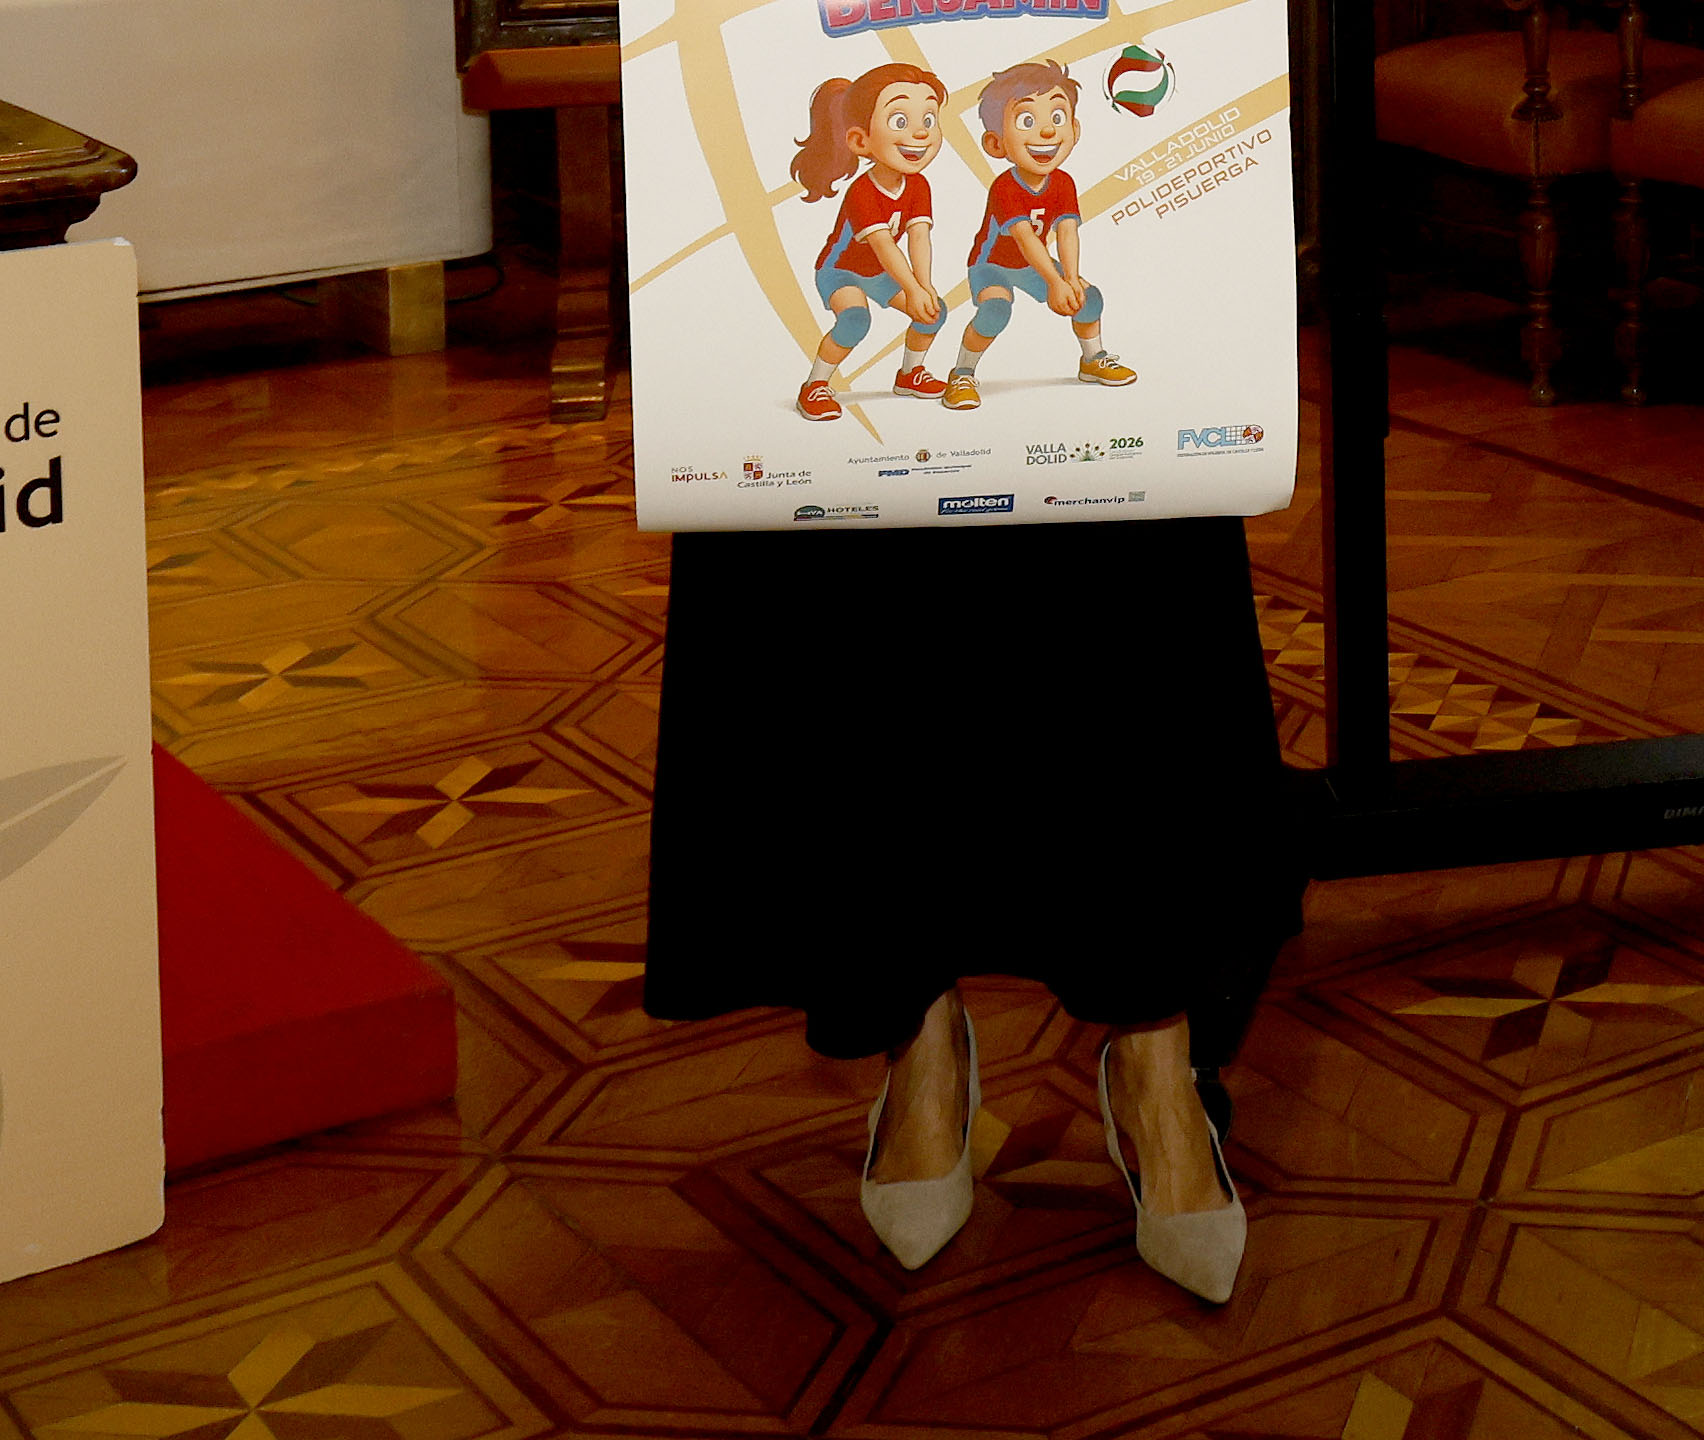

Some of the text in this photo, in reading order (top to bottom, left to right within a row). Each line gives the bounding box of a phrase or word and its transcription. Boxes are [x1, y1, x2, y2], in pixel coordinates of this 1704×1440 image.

[1114, 106, 1241, 182] VALLADOLID
[1185, 124, 1236, 158] JUNIO
[1111, 128, 1272, 225] POLIDEPORTIVO
[1155, 156, 1260, 219] PISUERGA
[1030, 208, 1046, 236] 5
[4, 401, 61, 443] de
[1026, 443, 1067, 454] VALLA
[1110, 437, 1144, 449] 2026
[848, 454, 910, 464] Ayuntamiento
[950, 448, 992, 457] Valladolid
[1026, 454, 1067, 465] DOLID
[672, 471, 728, 483] IMPULSA
[737, 477, 812, 488] Castilla y León
[943, 497, 1009, 509] molten
[1054, 496, 1125, 506] merchanvip
[827, 505, 879, 513] HOTELES
